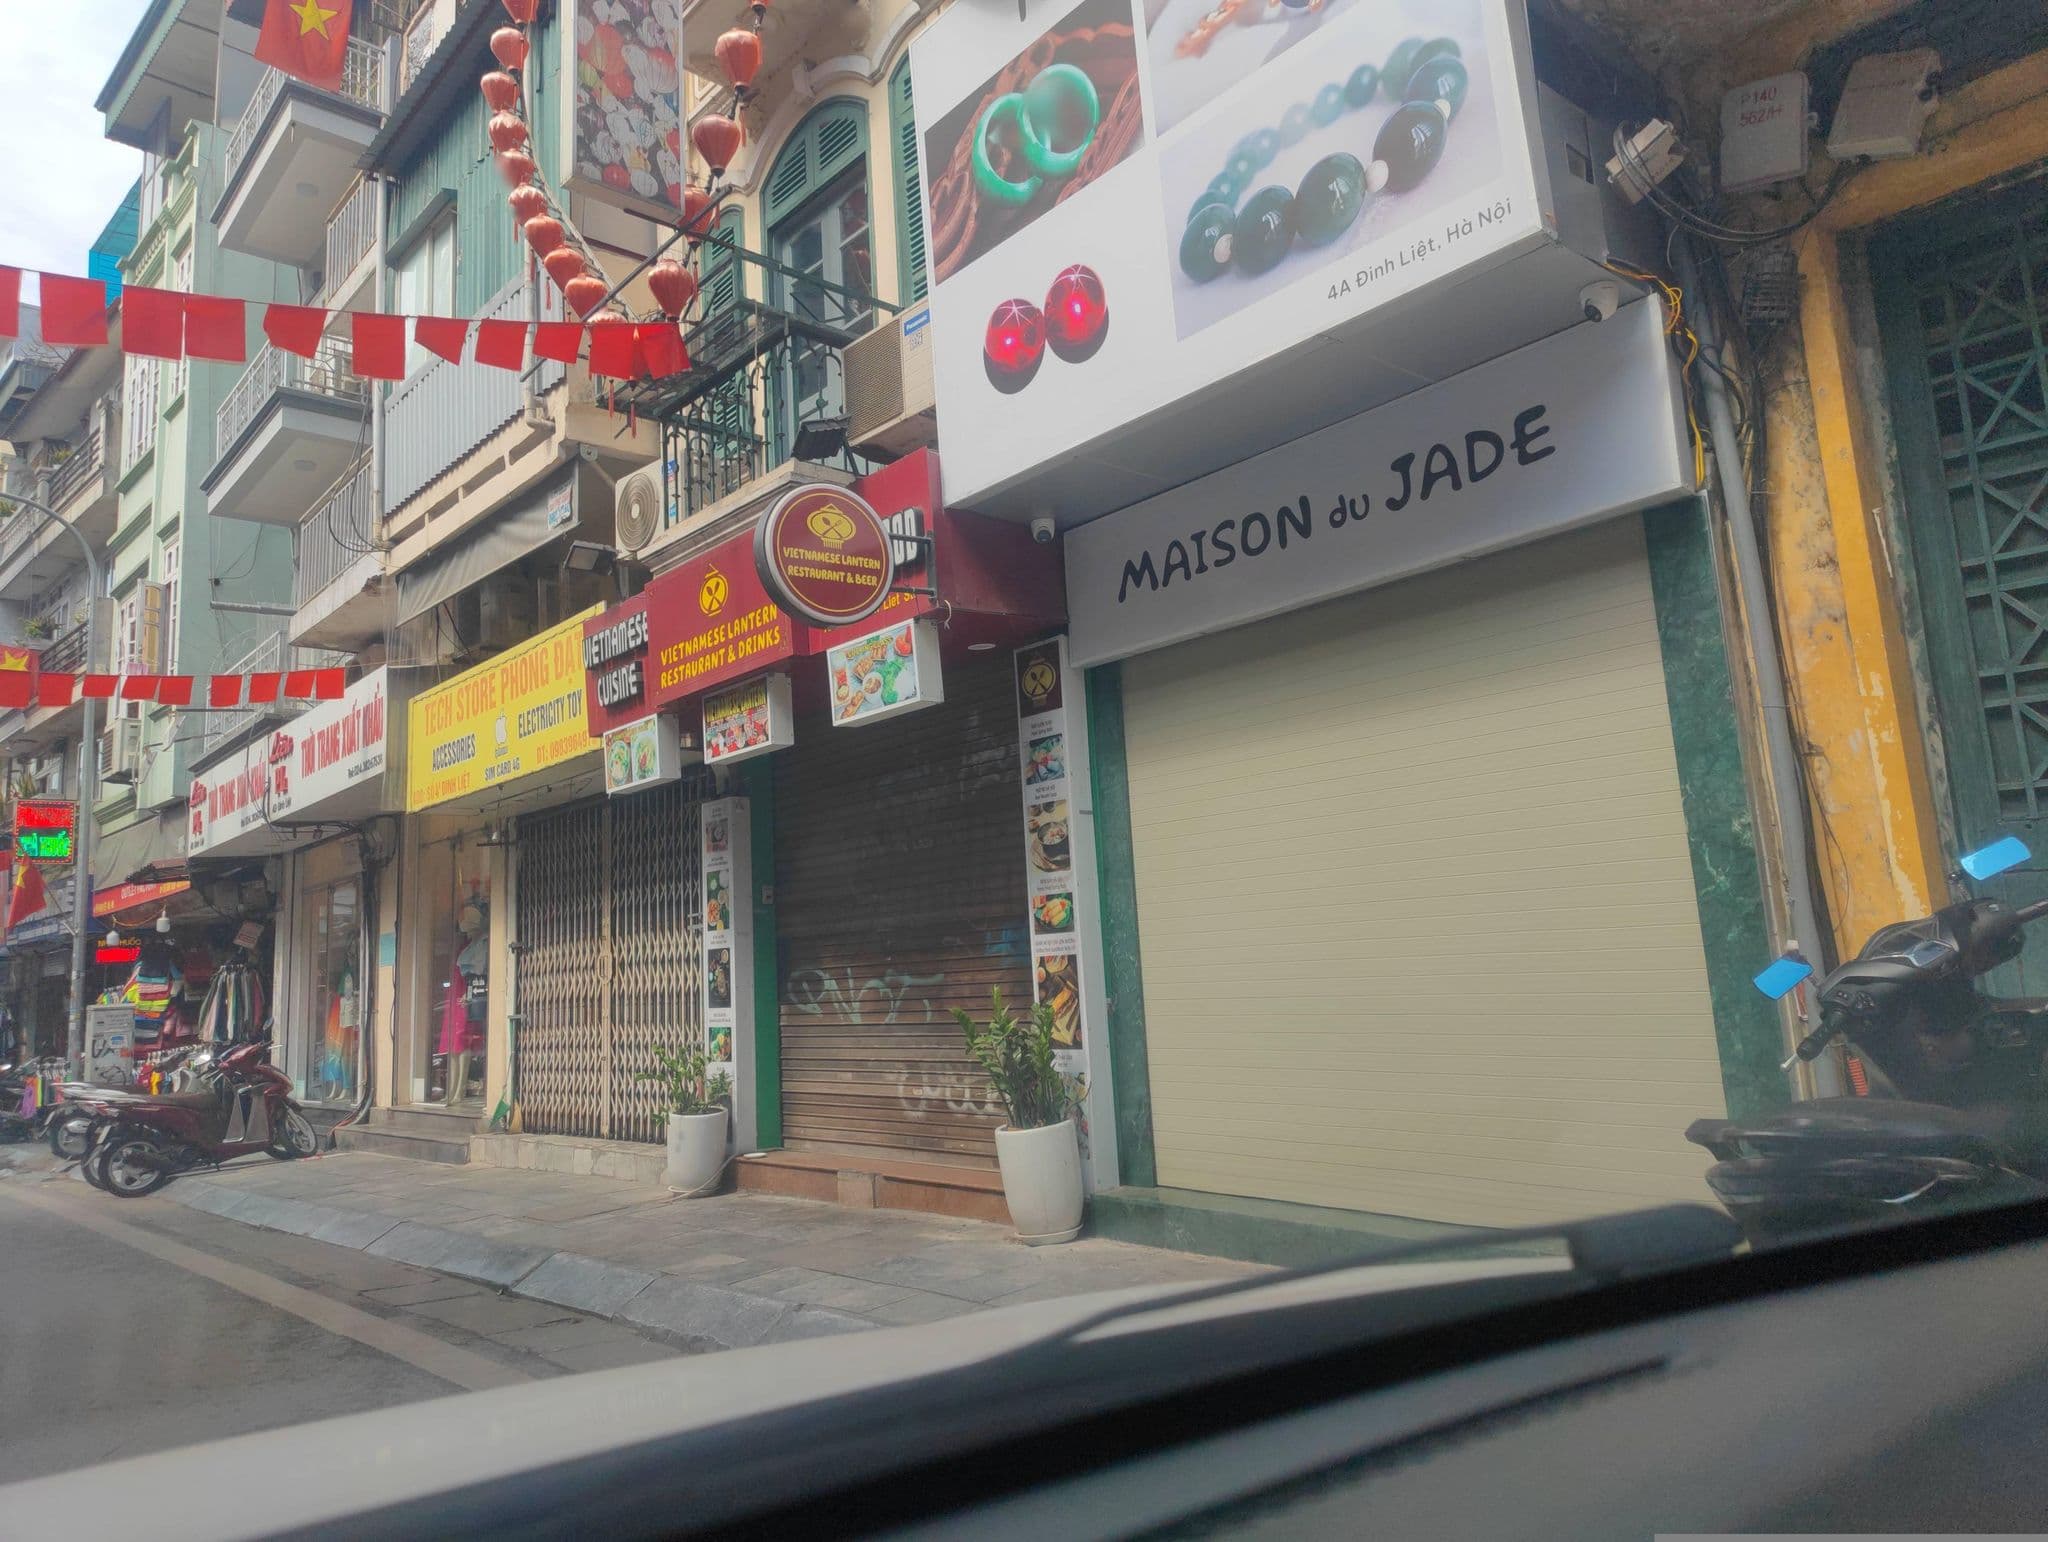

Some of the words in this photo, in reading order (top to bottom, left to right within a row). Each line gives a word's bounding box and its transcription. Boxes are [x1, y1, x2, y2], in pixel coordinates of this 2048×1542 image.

[1327, 279, 1351, 300] 4A
[1355, 258, 1395, 288] Đinh
[1399, 237, 1441, 266] Liệt,
[1446, 217, 1473, 243] Hà
[1478, 197, 1512, 227] Nội
[1118, 495, 1312, 603] MAISON
[1329, 494, 1369, 528] du
[1384, 404, 1556, 511] JADE
[783, 546, 841, 565] VIETNAMESE
[841, 555, 881, 570] LANTERN
[787, 564, 846, 583] RESTAURANT
[846, 574, 854, 584] &
[855, 574, 878, 587] BEER
[582, 610, 649, 669] VIETNAMESE
[660, 623, 726, 666] VIETNAMESE
[727, 604, 778, 640] LANTERN
[660, 647, 726, 689] RESTAURANT
[727, 644, 736, 664] &
[738, 625, 781, 658] DRINKS
[424, 693, 453, 736] TECH
[456, 671, 497, 722] STORE
[500, 645, 549, 704] PHONG
[597, 661, 638, 707] CUISINE
[517, 696, 565, 739] ELECTRICITY
[568, 688, 583, 720] TOY
[317, 720, 340, 771] TRANG
[432, 733, 477, 772] ACCESSORIES
[484, 766, 495, 781] SIM
[496, 760, 511, 777] CARD
